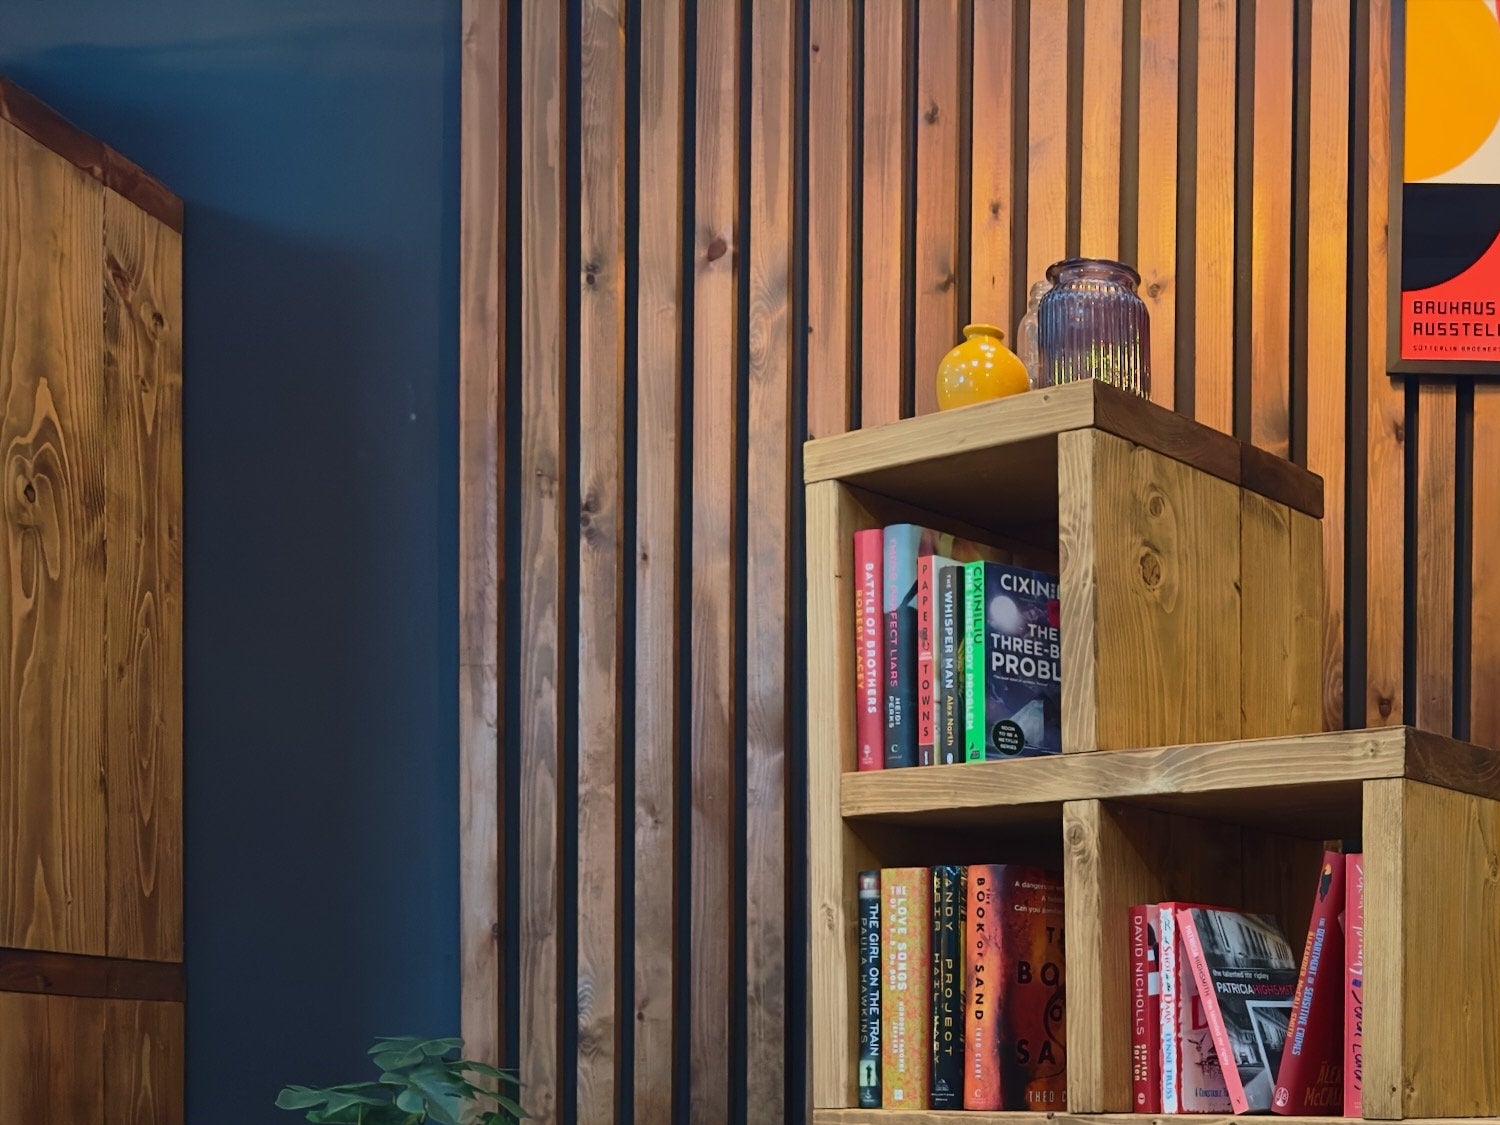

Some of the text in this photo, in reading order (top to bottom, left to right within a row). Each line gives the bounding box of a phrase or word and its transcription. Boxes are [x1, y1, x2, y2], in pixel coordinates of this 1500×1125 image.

[1413, 301, 1496, 316] BAUHAUS
[865, 562, 876, 714] BATTLE OF BROTHERS
[889, 584, 897, 645] PERFECT
[944, 592, 953, 653] WHISPER
[1028, 624, 1058, 641] THE
[890, 649, 898, 688] LIARS
[945, 656, 954, 688] MAN
[894, 698, 902, 725] HEIDI
[946, 696, 954, 716] Alex
[976, 878, 985, 933] BOOK
[898, 898, 907, 992] LOVE SONGS
[860, 918, 868, 1044] PAULA HAWKINS
[869, 904, 879, 1056] THE GIRL ON THE TRAIN
[974, 964, 984, 1020] SAND
[1134, 916, 1145, 1036] DAVID NICHOLLS
[1164, 1033, 1172, 1064] LYNNE
